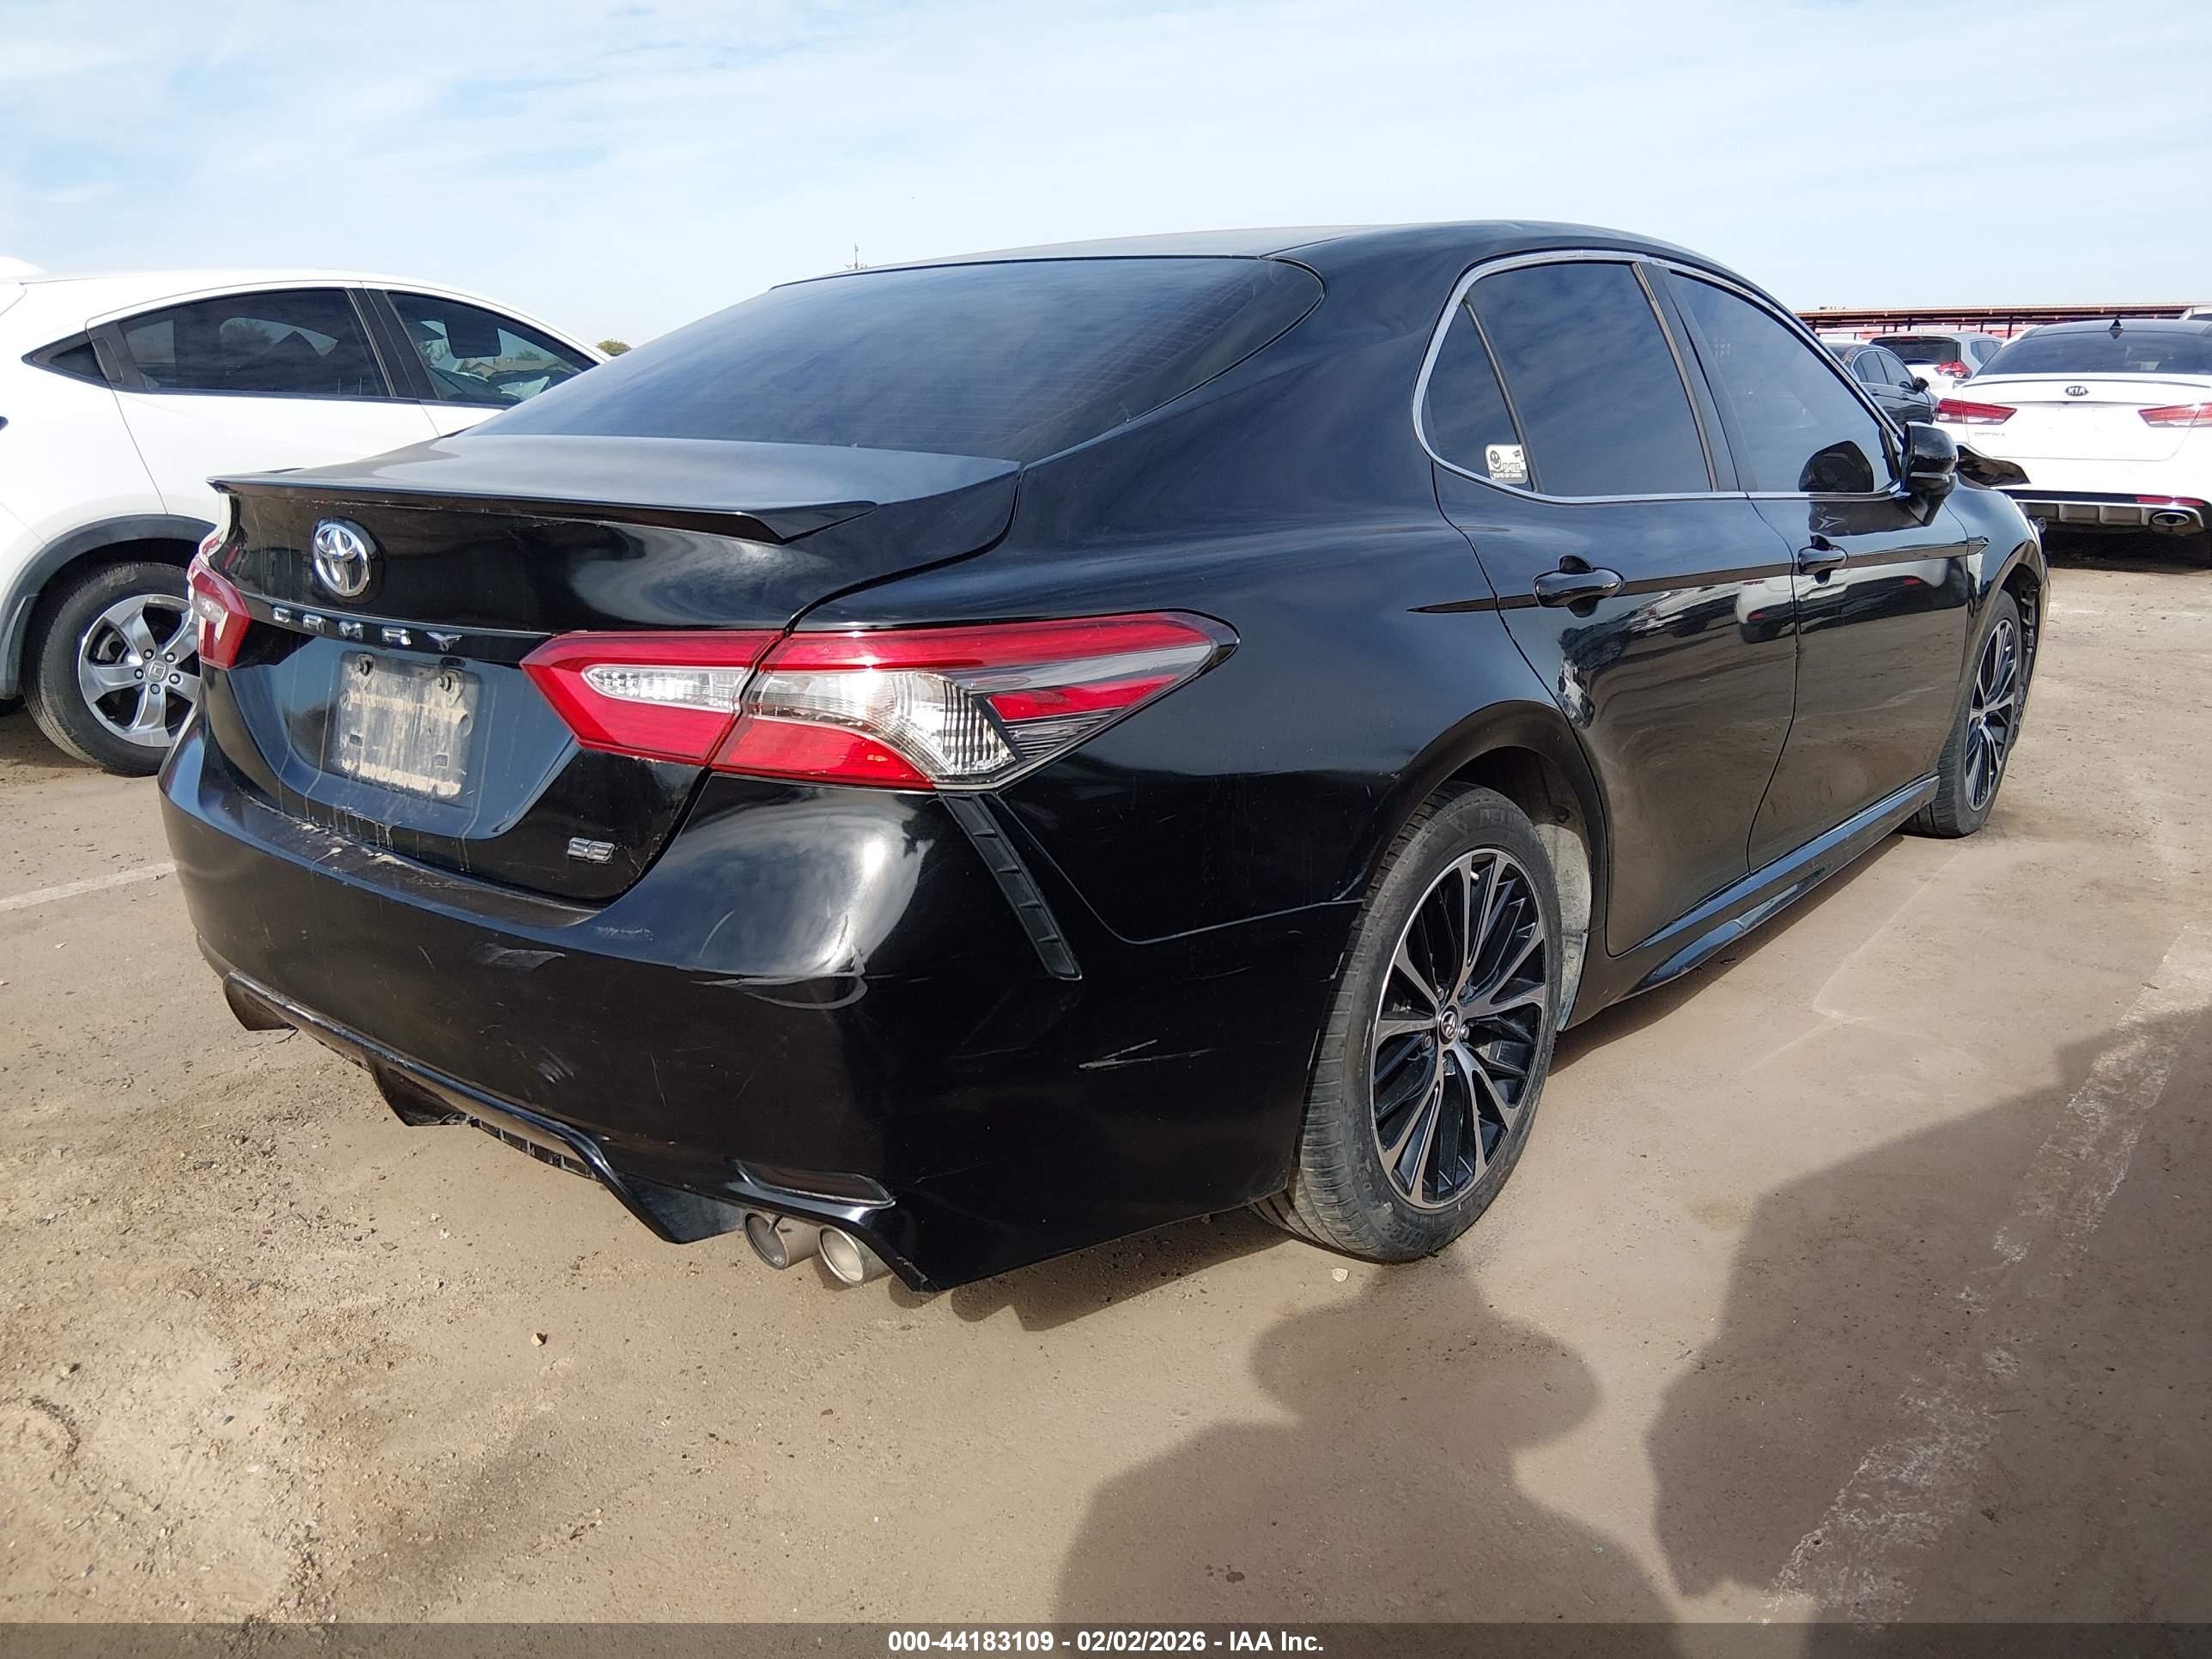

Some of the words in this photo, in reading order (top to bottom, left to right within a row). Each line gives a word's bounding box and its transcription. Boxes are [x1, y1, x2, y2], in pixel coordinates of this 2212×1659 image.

[2067, 386, 2087, 396] KIA
[272, 606, 463, 653] CAMRY
[567, 837, 616, 863] SE
